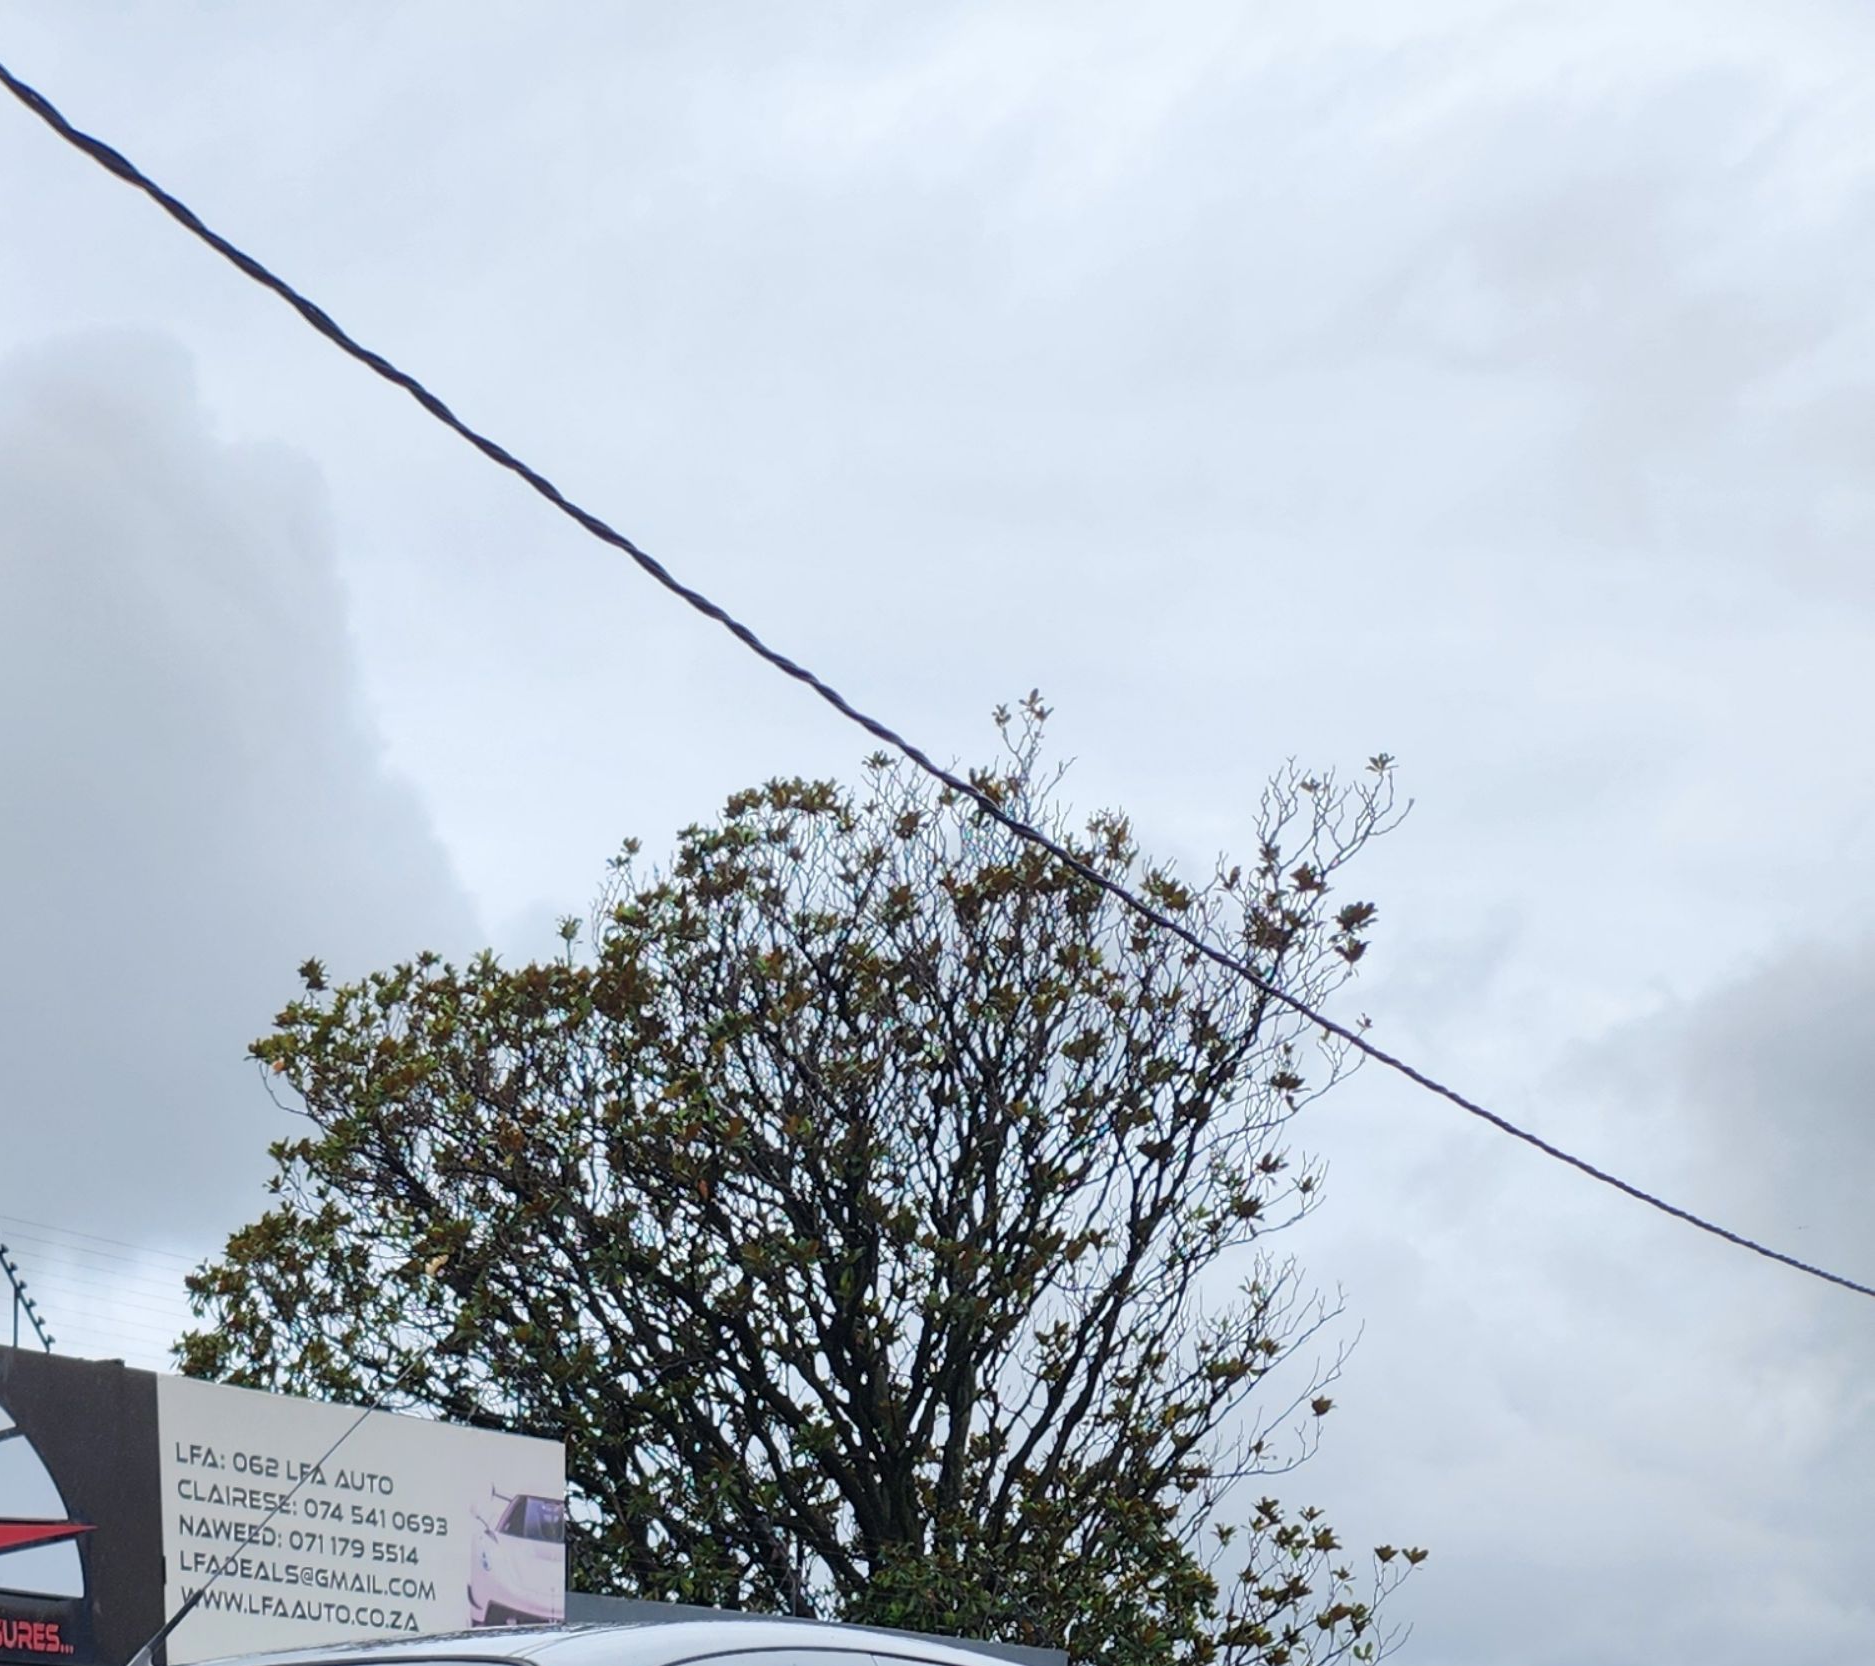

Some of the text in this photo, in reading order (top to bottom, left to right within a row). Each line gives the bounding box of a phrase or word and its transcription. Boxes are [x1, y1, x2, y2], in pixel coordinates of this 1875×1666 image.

[175, 1442, 393, 1495] LFA: 062 LFA AUTO
[177, 1479, 448, 1536] CLAIRESE: 074 541 0693
[179, 1514, 419, 1565] NAWEED: 071 179 5514
[179, 1550, 437, 1601] LFADEALS@GMAIL.COM
[181, 1586, 420, 1633] WWW.LFAAUTO.CO.ZA
